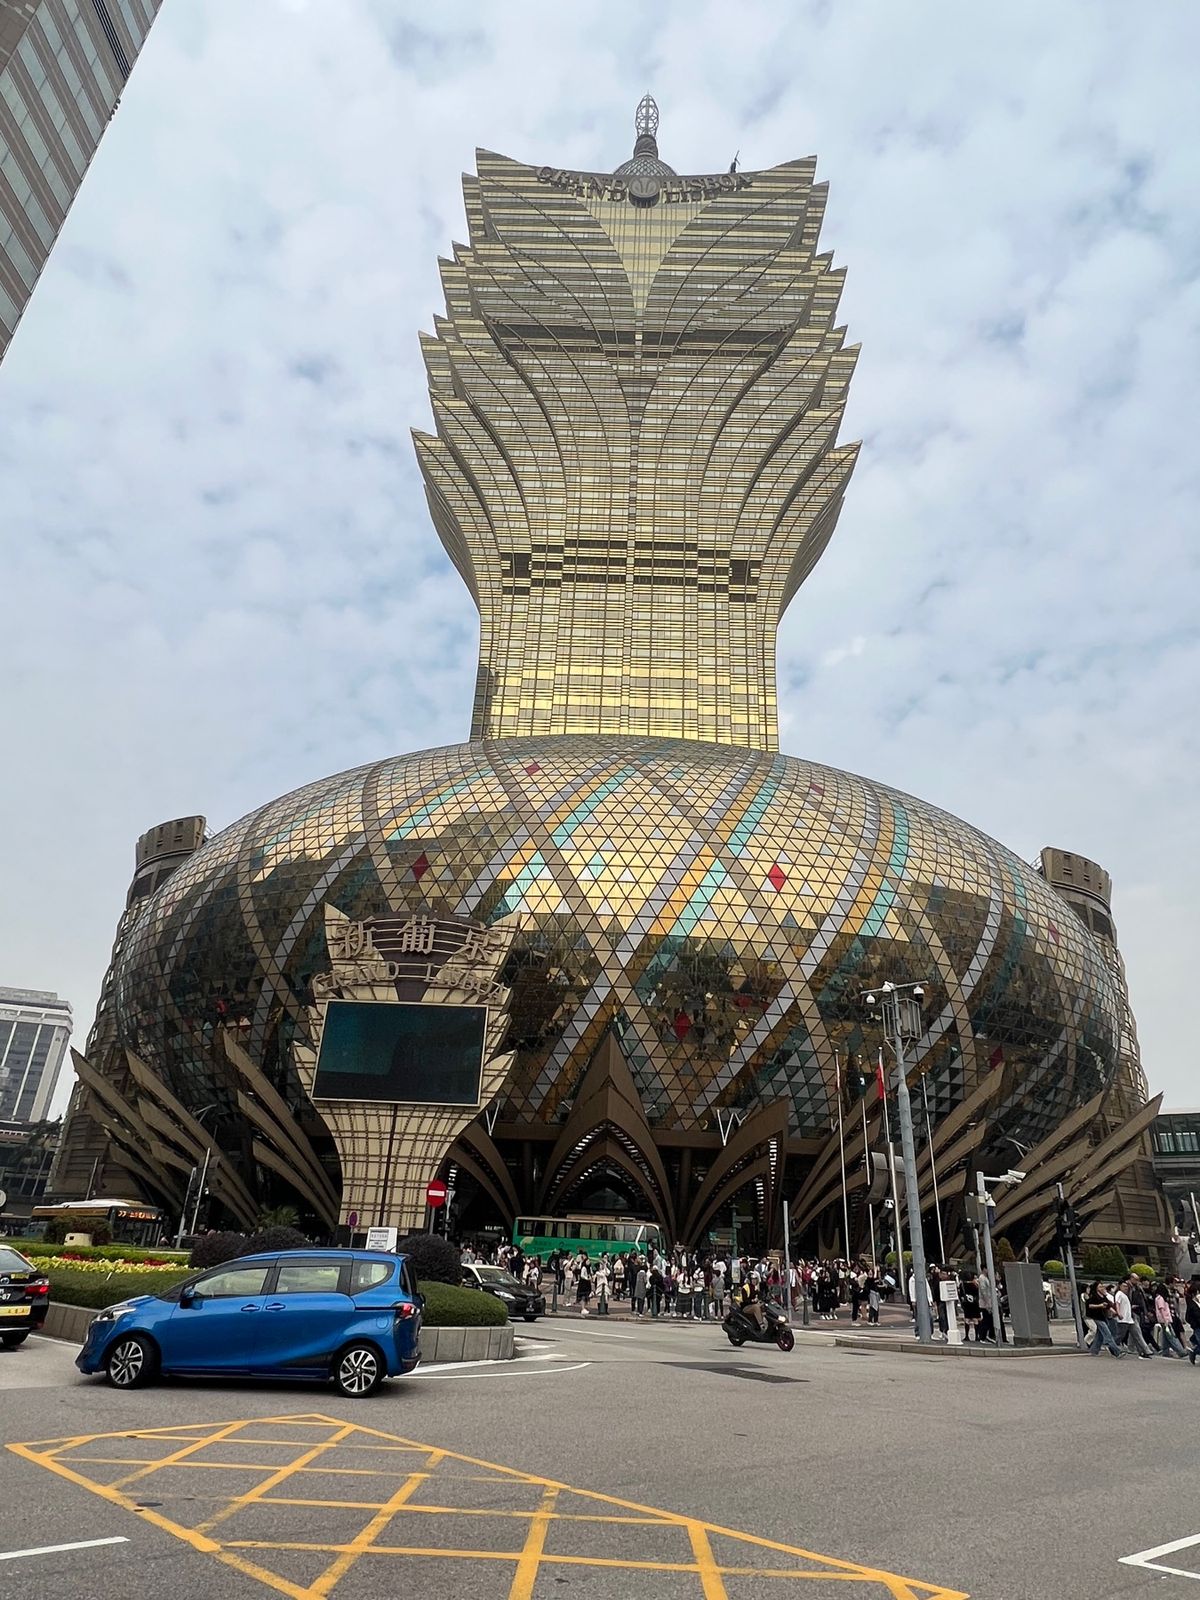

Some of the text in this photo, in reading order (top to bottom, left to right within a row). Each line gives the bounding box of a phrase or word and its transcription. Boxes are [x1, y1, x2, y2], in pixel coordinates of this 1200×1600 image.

[536, 166, 753, 196] GRAND LISBOA
[336, 914, 501, 963] 新葡京
[313, 961, 504, 1000] GRAND LISBOA
